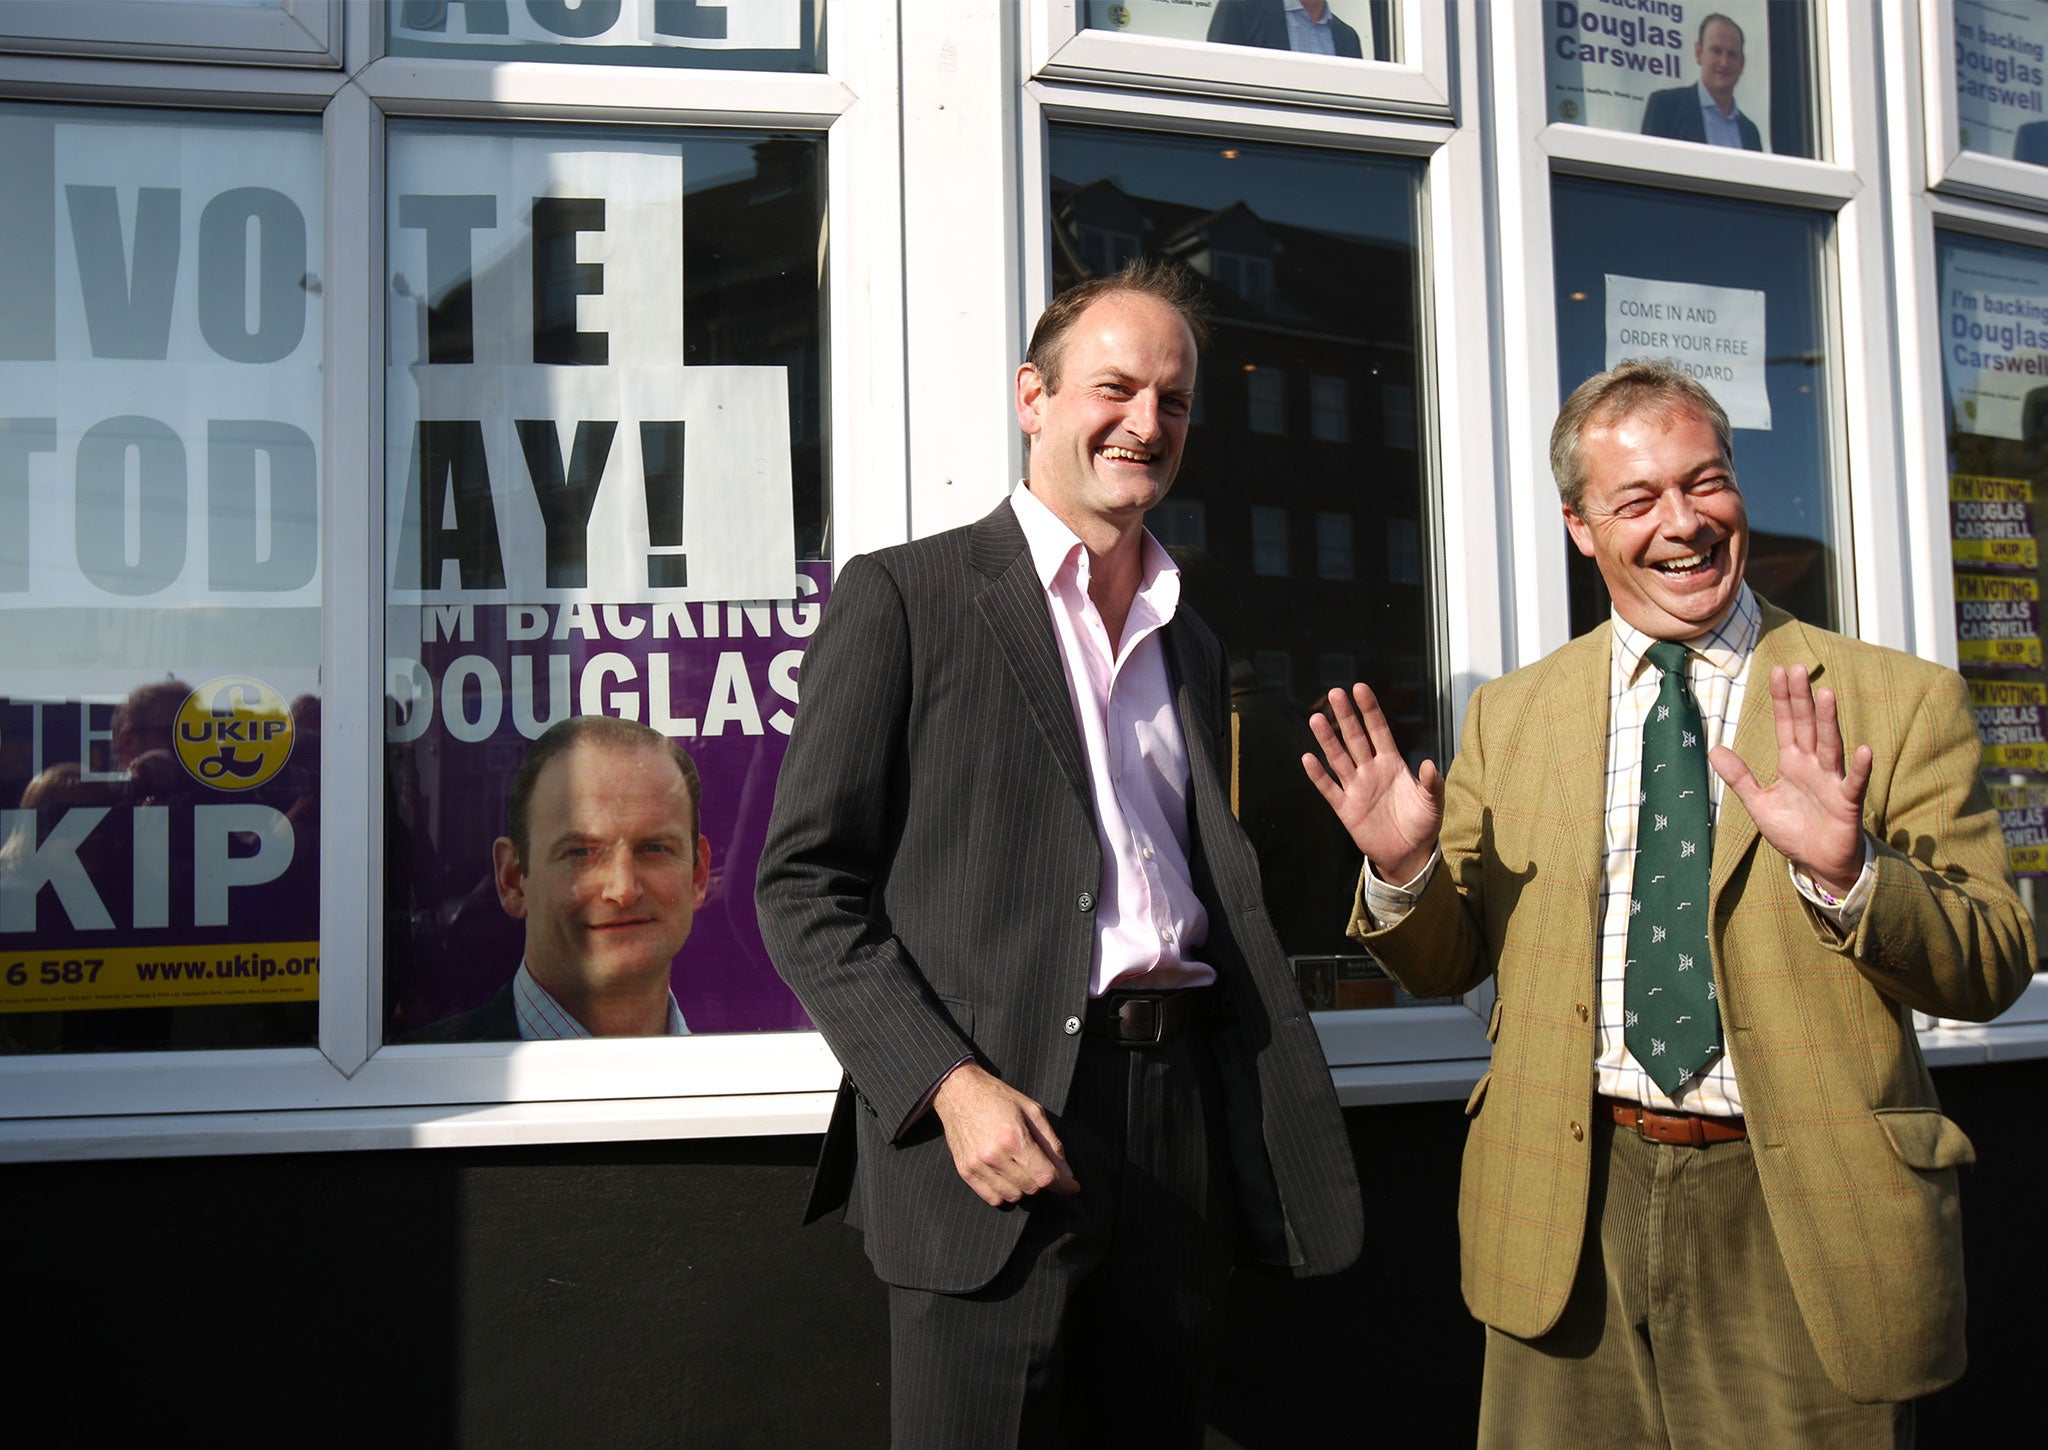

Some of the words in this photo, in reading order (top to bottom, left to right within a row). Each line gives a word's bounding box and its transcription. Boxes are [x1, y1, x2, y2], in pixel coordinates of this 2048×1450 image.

[1598, 0, 1683, 23] acking
[1556, 1, 1683, 49] Douglas
[1978, 24, 2043, 63] backing
[1556, 35, 1681, 79] Carswell
[64, 184, 609, 366] VOTE
[1620, 300, 1663, 320] COME
[1667, 305, 1682, 321] IN
[1686, 308, 1717, 325] AND
[1951, 289, 1977, 311] I'm
[1983, 294, 2048, 326] backing
[1620, 329, 1670, 348] ORDER
[1672, 334, 1712, 352] YOUR
[1716, 338, 1749, 356] FREE
[1952, 313, 2048, 351] Douglas
[1954, 343, 2048, 375] Carswell
[1684, 363, 1734, 382] BOARD
[1976, 479, 2026, 501] VOTING
[1957, 503, 2026, 520] DOUGLAS
[1955, 521, 2031, 539] CARSWELL
[1991, 542, 2020, 556] UKIP
[1981, 580, 2032, 600] VOTING
[506, 574, 821, 642] BACKING
[1962, 601, 2031, 620] DOUGLAS
[1960, 620, 2036, 639] CARSWELL
[1995, 642, 2024, 656] UKIP
[386, 649, 804, 743] DOUGLAS
[1990, 685, 2040, 703] VOTING
[0, 694, 131, 783] TE
[180, 720, 288, 743] UKIP
[1980, 726, 2045, 744] ARSWELL
[2004, 747, 2033, 761] UKIP
[1999, 808, 2044, 828] UGLAS
[2005, 827, 2048, 848] SWELL
[6, 961, 28, 986] 6
[40, 959, 105, 985] 587
